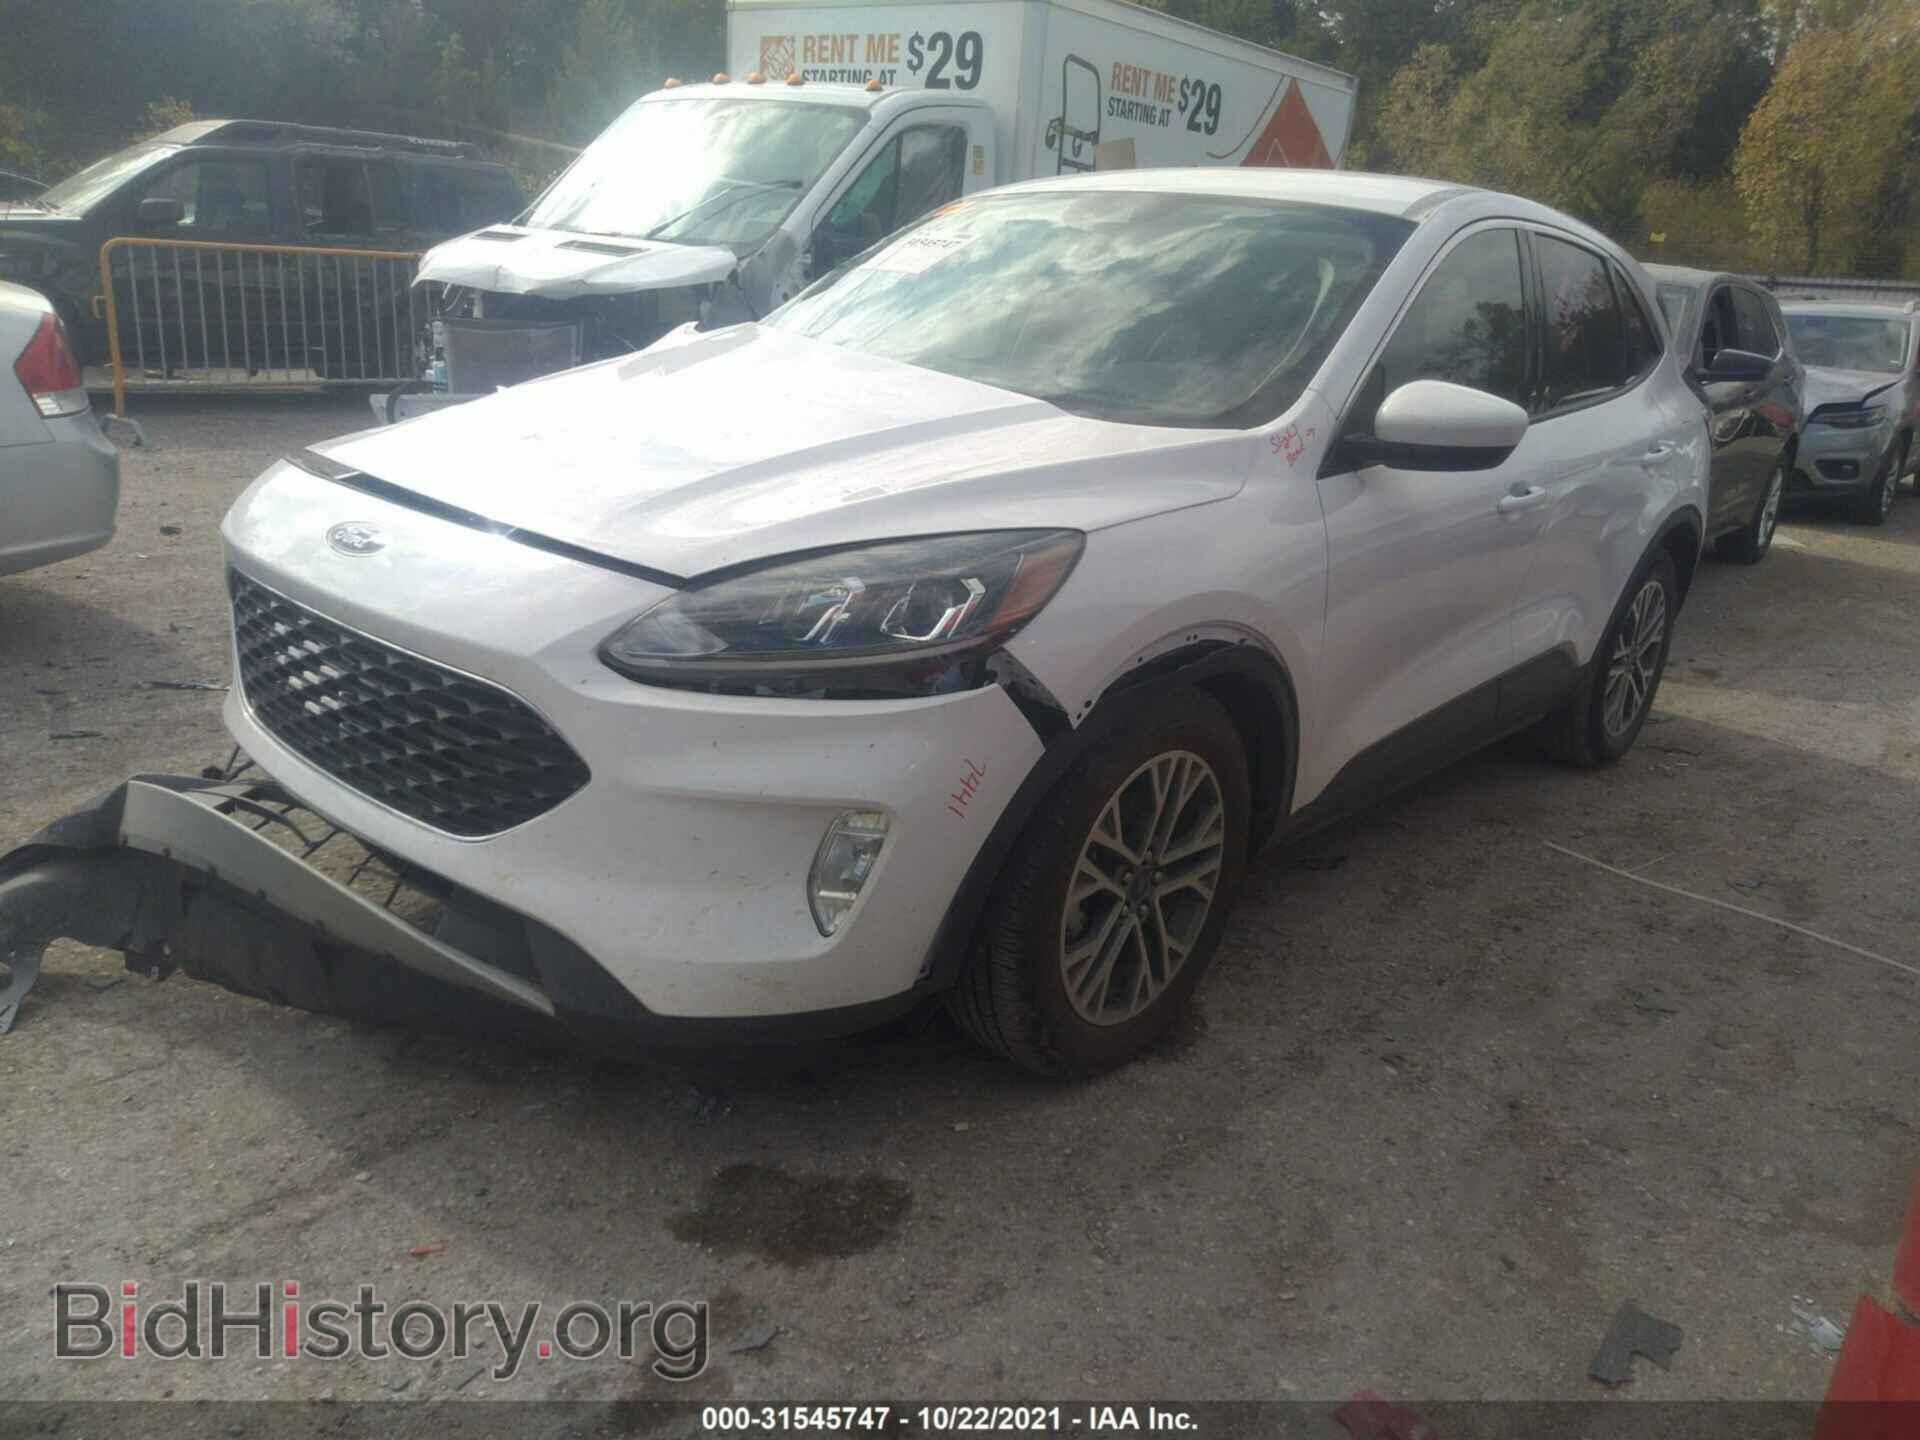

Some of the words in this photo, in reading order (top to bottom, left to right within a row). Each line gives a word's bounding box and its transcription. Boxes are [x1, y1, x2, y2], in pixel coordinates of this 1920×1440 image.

[802, 34, 858, 64] RENT
[865, 34, 900, 64] ME
[906, 30, 984, 90] $29
[802, 69, 873, 84] STARTING
[879, 69, 897, 86] AT
[1110, 62, 1152, 97] RENT
[1153, 72, 1177, 103] ME
[1107, 96, 1157, 126] STARTING
[1158, 108, 1171, 128] AT
[1178, 74, 1222, 136] $29
